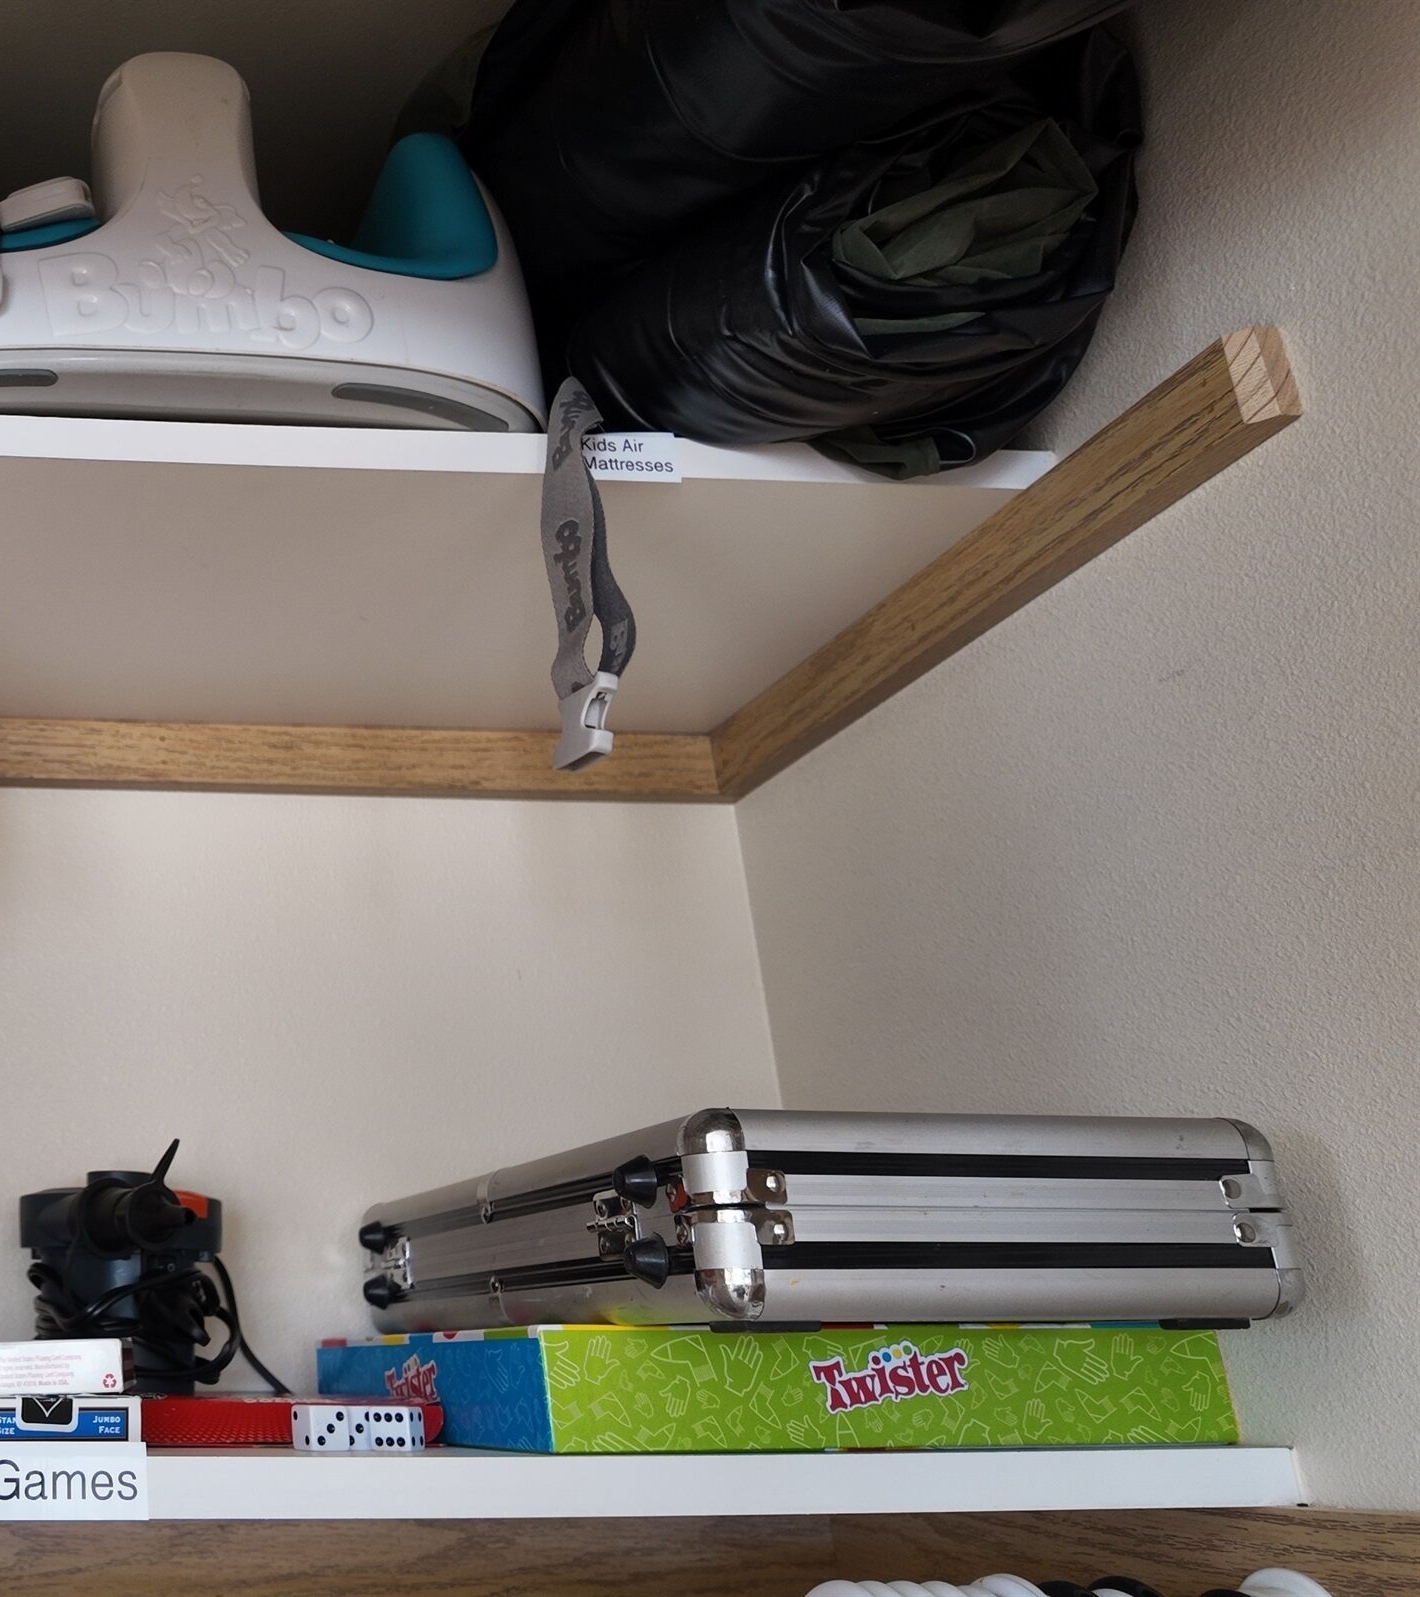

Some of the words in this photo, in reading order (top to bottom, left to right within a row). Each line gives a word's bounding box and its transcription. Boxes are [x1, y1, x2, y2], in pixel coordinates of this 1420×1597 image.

[38, 253, 374, 349] Bumbo
[581, 437, 616, 452] Kids
[622, 439, 644, 452] Air
[583, 457, 674, 473] Mattresses
[553, 519, 586, 633] Bumbo
[811, 1350, 967, 1412] Twister
[92, 1415, 121, 1424] JUMBO
[98, 1425, 121, 1434] FACE
